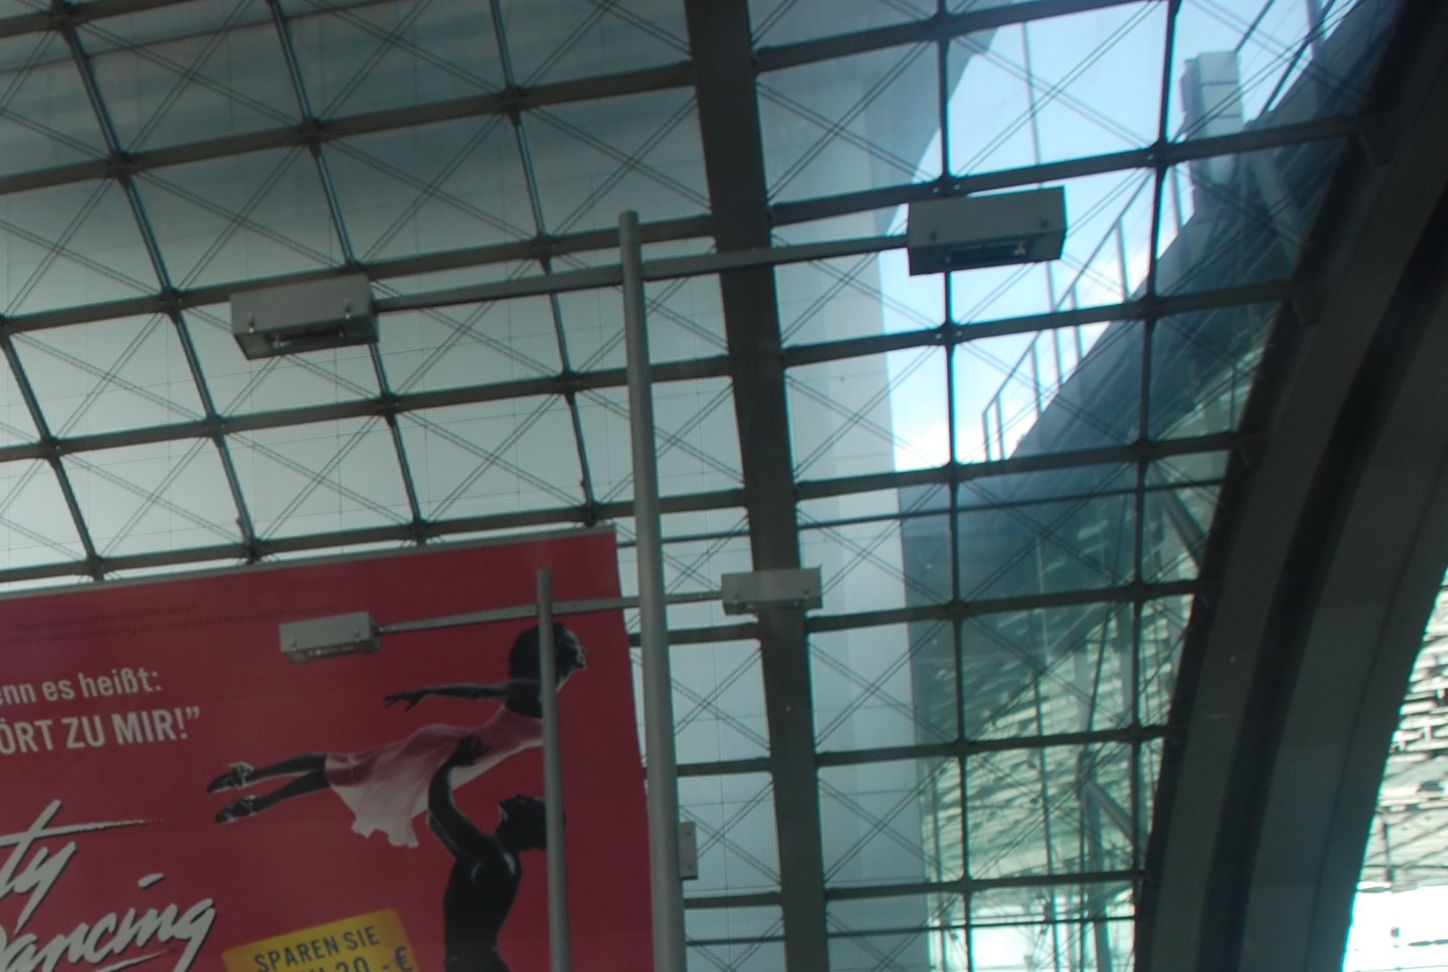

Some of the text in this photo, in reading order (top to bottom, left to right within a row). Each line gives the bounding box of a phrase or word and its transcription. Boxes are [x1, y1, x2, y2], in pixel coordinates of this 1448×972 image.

[42, 679, 72, 702] es
[77, 666, 163, 698] heißt:
[62, 714, 105, 750] ZU
[344, 926, 380, 951] SIE
